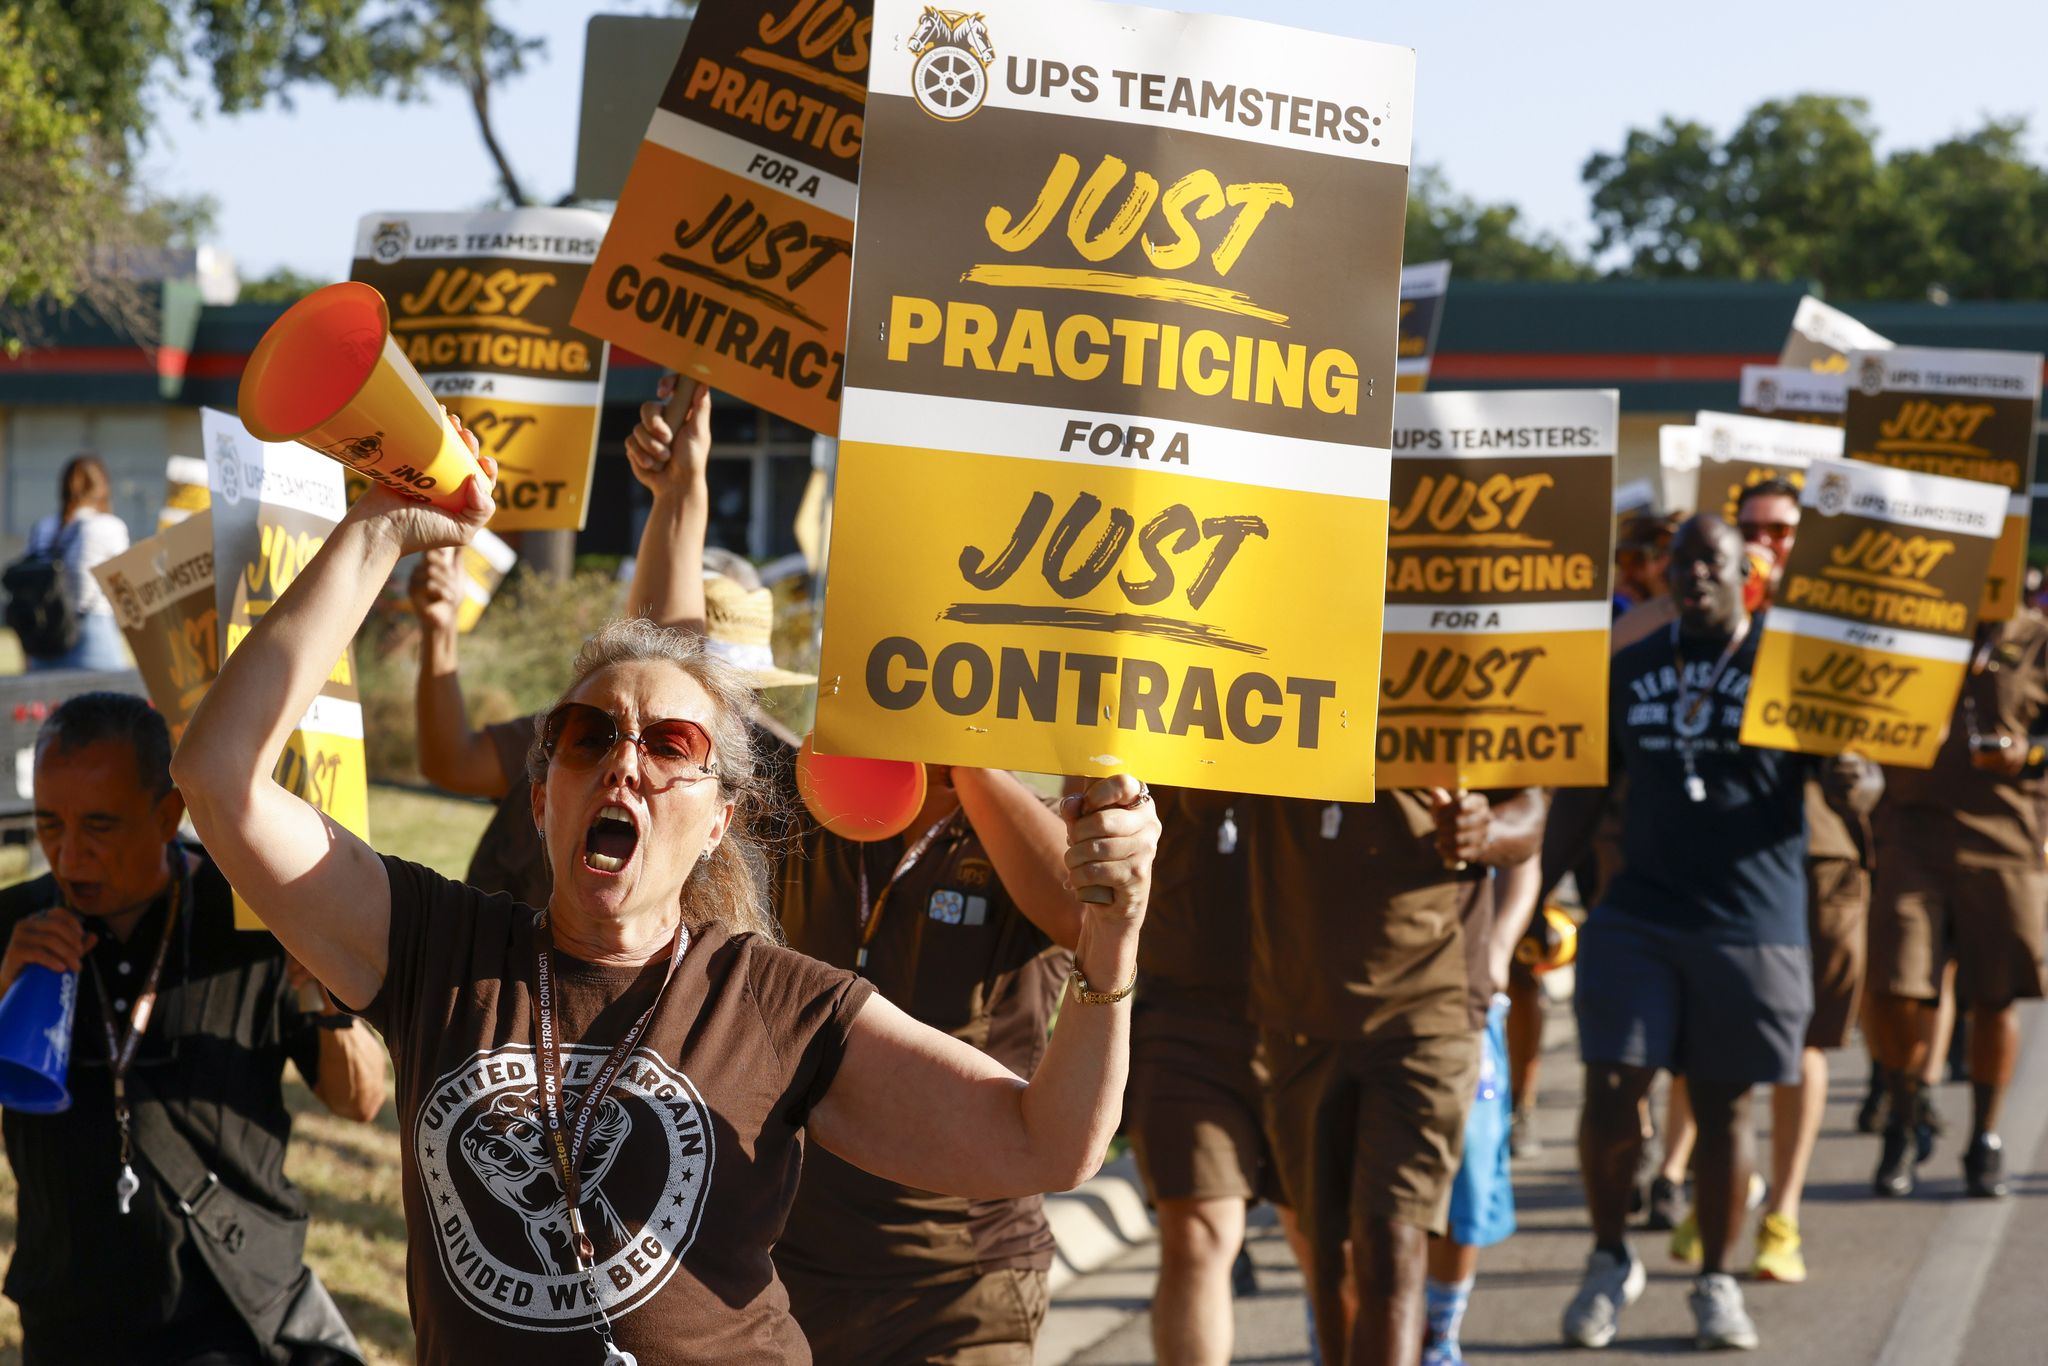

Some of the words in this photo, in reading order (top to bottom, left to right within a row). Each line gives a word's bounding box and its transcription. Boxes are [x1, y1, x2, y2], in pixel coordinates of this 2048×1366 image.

[1006, 55, 1100, 103] UPS
[1112, 69, 1382, 148] TEAMSTERS:
[747, 153, 799, 189] FOR
[799, 174, 821, 199] A
[984, 153, 1295, 277] JUST
[413, 234, 459, 250] UPS
[675, 193, 853, 293] JUST
[400, 267, 558, 316] JUST
[605, 264, 846, 402] CONTRACT
[886, 295, 1360, 417] PRACTICING
[432, 376, 476, 393] FOR
[480, 379, 495, 393] A
[1059, 420, 1155, 461] FOR
[1160, 432, 1191, 466] A
[1393, 429, 1442, 450] UPS
[1450, 426, 1600, 451] TEAMSTERS:
[1879, 400, 1996, 441] JUST
[1389, 472, 1555, 532] JUST
[1851, 491, 1888, 513] UPS
[957, 490, 1270, 612] JUST
[1830, 528, 1956, 580] JUST
[1429, 609, 1481, 629] FOR
[1484, 610, 1502, 628] A
[1786, 575, 1970, 633] PRACTICING
[864, 635, 1337, 751] CONTRACT
[1382, 645, 1548, 702] JUST
[1800, 652, 1922, 700] JUST
[1376, 723, 1584, 765] ONTRACT
[1762, 700, 1931, 748] CONTRACT
[538, 952, 551, 1008] CONTRACT!
[540, 1008, 553, 1050] STRONG
[614, 1043, 630, 1060] FOR
[624, 1026, 640, 1043] ON
[544, 1058, 554, 1073] FOR
[545, 1075, 556, 1094] ON
[586, 1066, 615, 1106] STRONG
[423, 1061, 528, 1132] UNITED
[546, 1094, 559, 1130] GAME
[442, 1213, 535, 1308] DIVIDED
[606, 1235, 664, 1293] BEG
